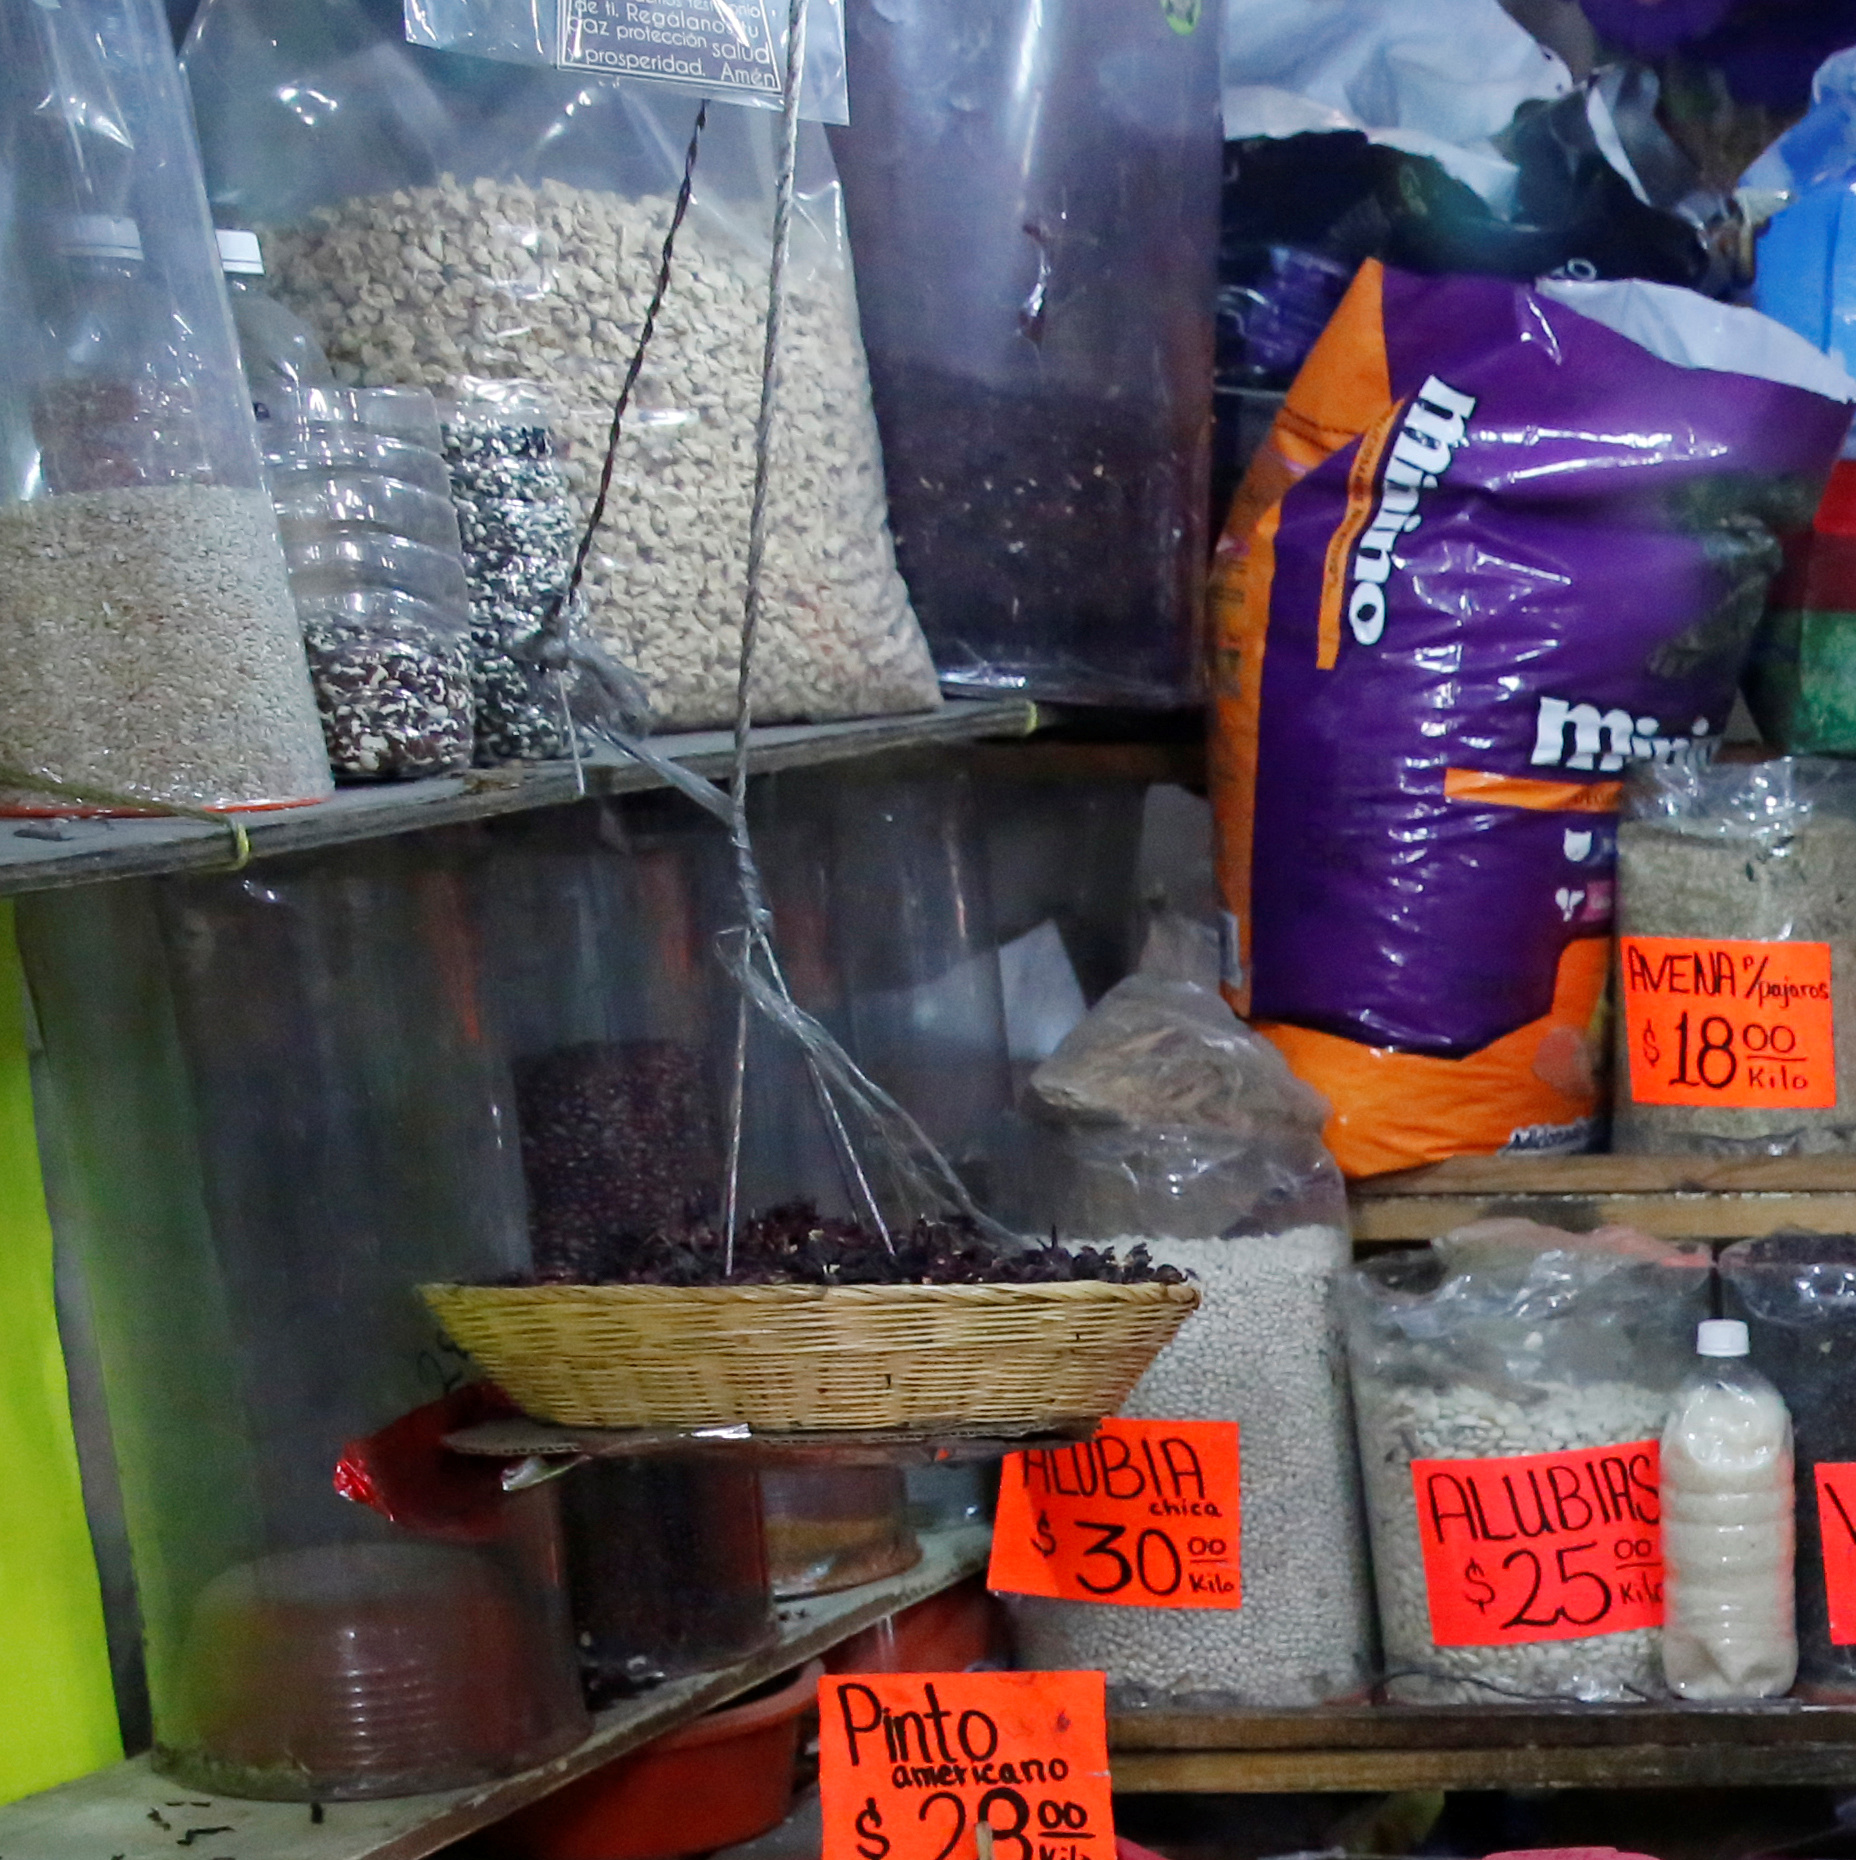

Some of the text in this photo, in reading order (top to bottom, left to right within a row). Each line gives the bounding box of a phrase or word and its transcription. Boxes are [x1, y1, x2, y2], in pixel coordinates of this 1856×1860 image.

[616, 26, 707, 48] protección
[712, 41, 770, 64] salud
[585, 47, 706, 77] prosperidad.
[720, 62, 776, 87] Amén
[1629, 952, 1737, 998] AVENA
[1642, 1012, 1796, 1090] $ 18 00
[1748, 1068, 1808, 1092] Kilo
[1022, 1435, 1205, 1500] ALUBIA
[1148, 1497, 1222, 1519] chica
[1426, 1454, 1660, 1547] ALUBIAS
[1030, 1511, 1228, 1597] $ 30 00
[1189, 1572, 1235, 1595] Kilo
[1464, 1537, 1653, 1630] $ 25 00
[837, 1683, 999, 1768] Pinto
[890, 1755, 1069, 1790] americano
[1038, 1799, 1088, 1830] 00
